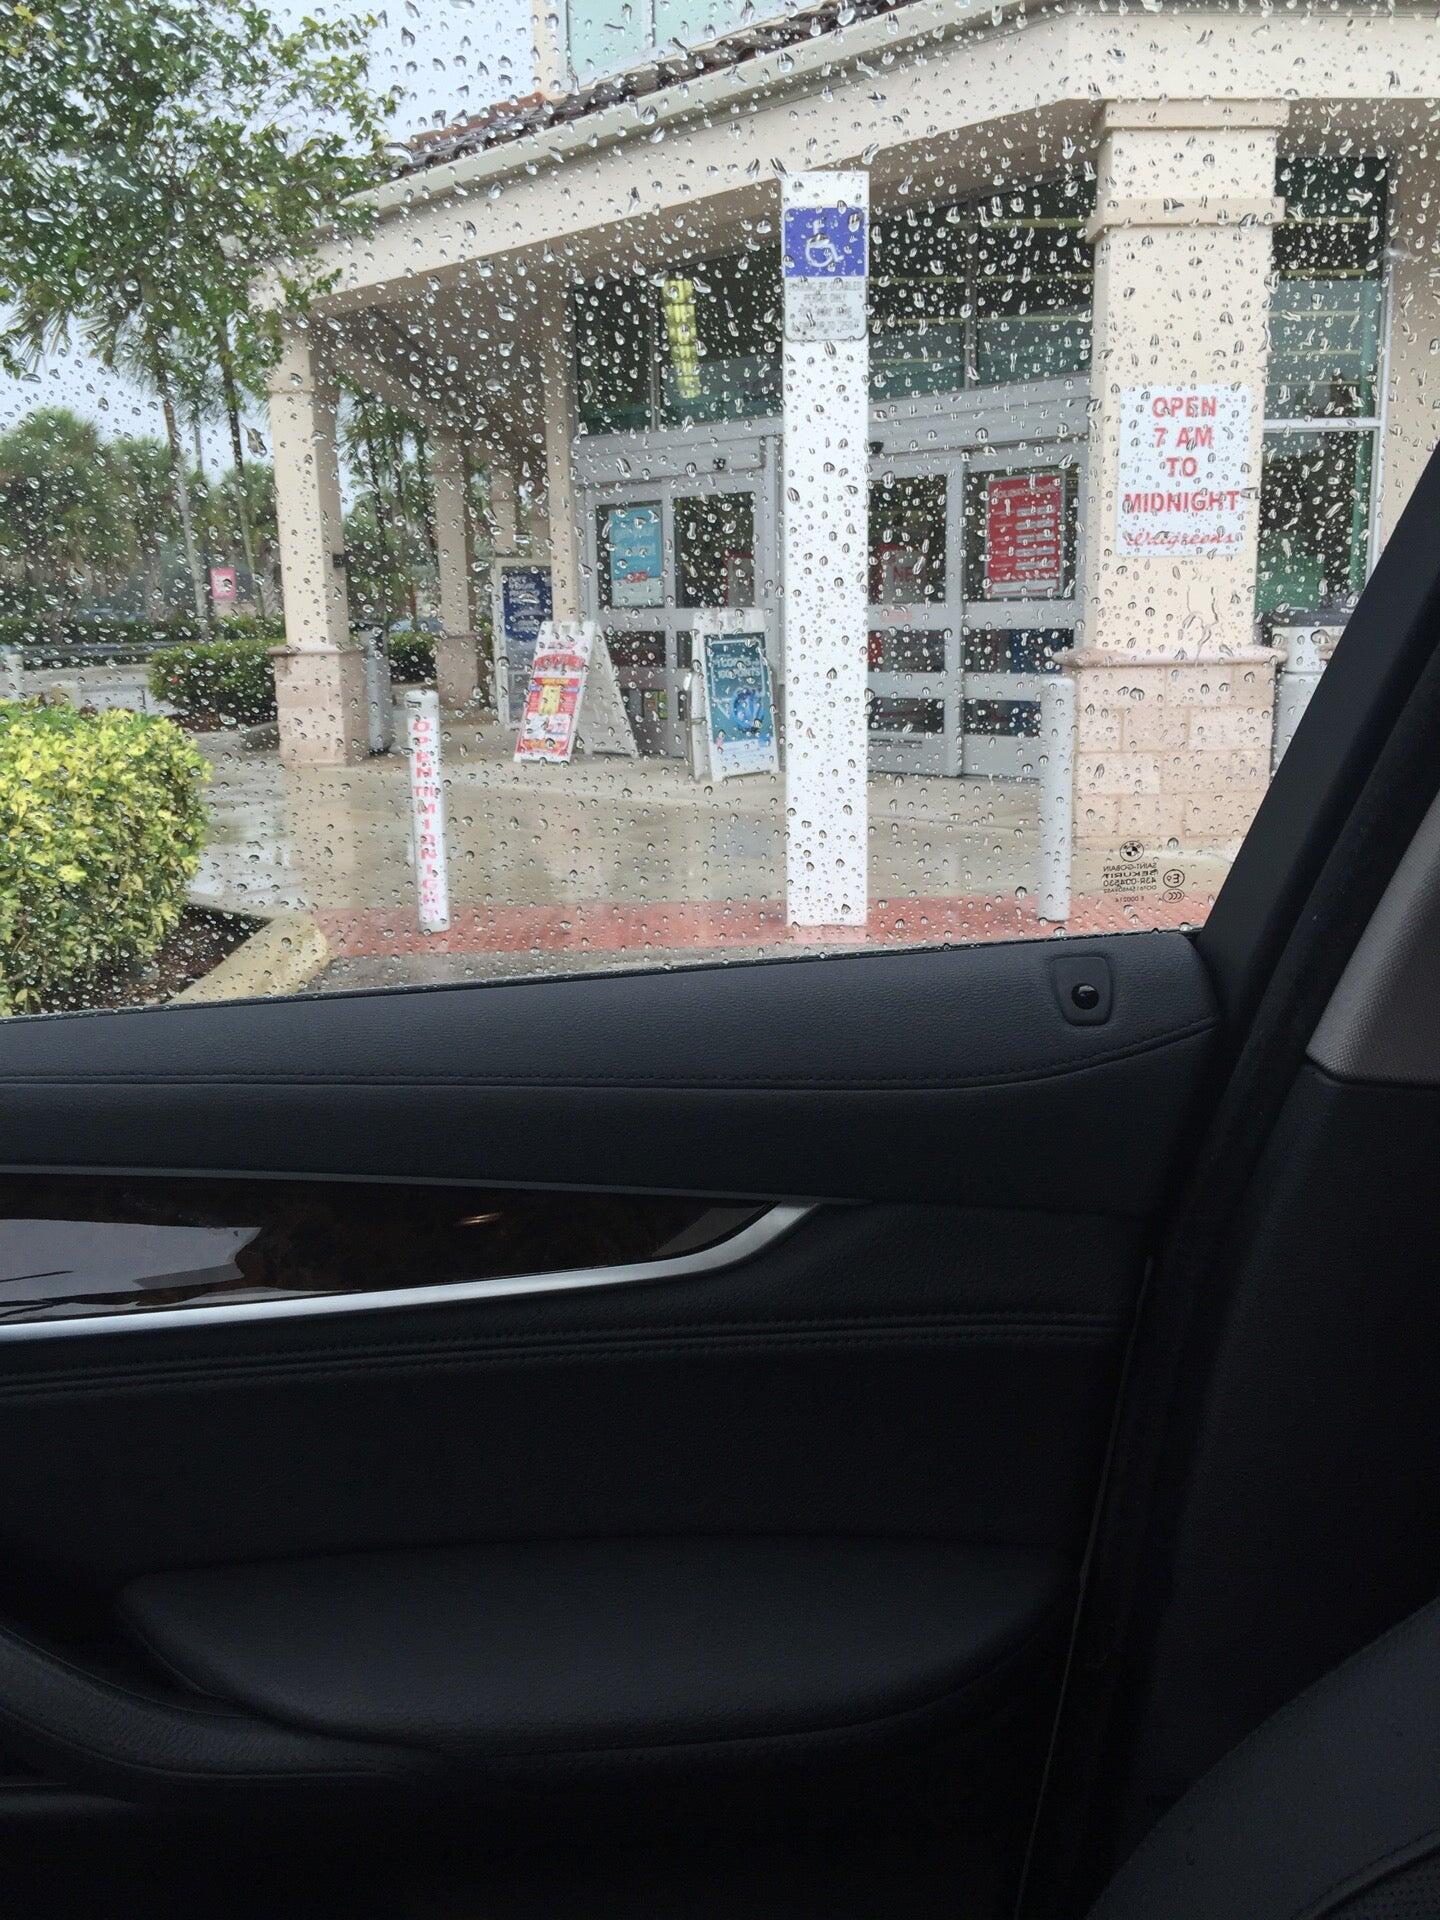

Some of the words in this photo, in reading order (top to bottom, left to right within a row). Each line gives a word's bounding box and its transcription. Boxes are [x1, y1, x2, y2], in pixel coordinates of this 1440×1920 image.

[1152, 397, 1217, 418] OPEN
[1153, 427, 1168, 448] 7
[1176, 427, 1214, 449] AM
[1166, 457, 1197, 478] TO
[1123, 490, 1240, 513] MIDNIGHT
[412, 721, 433, 778] OPEN
